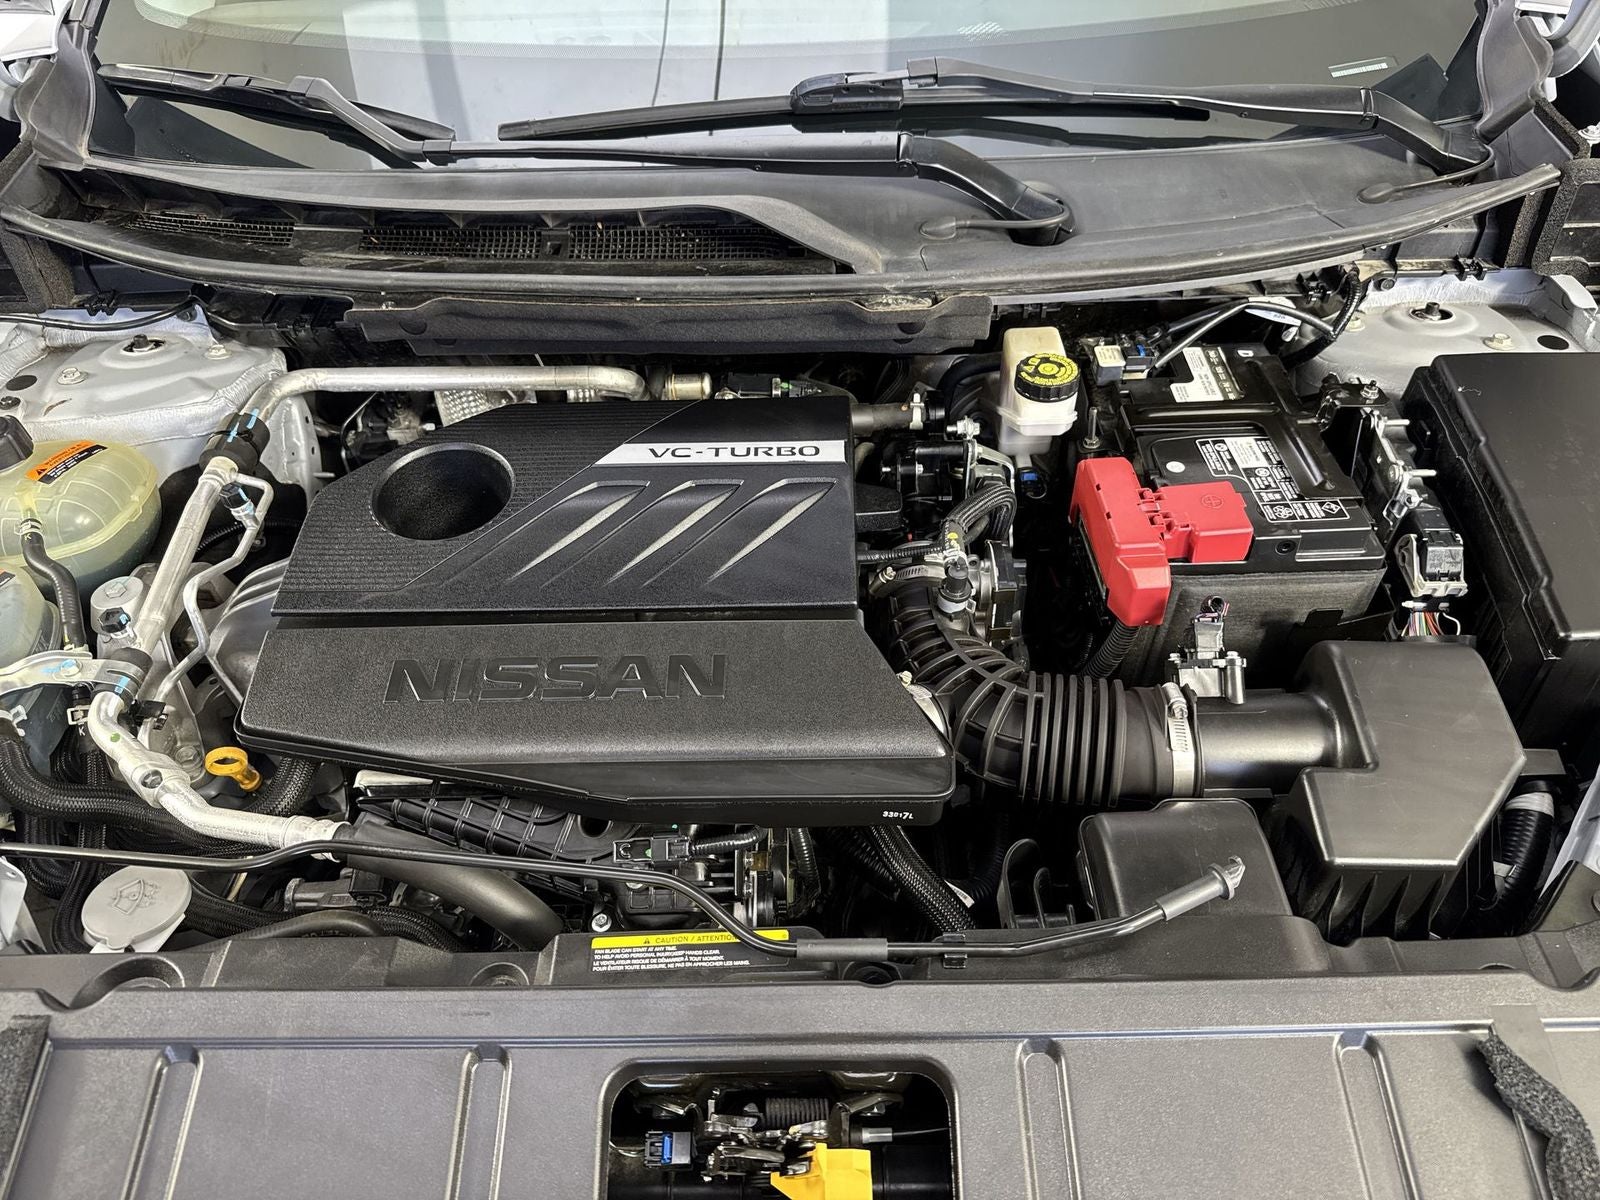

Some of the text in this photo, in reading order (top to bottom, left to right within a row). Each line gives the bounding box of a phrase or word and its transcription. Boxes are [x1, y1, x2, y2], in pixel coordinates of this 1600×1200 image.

[649, 445, 820, 458] VC-TURBO
[383, 654, 726, 704] NISSAN
[655, 936, 689, 944] CAUTION
